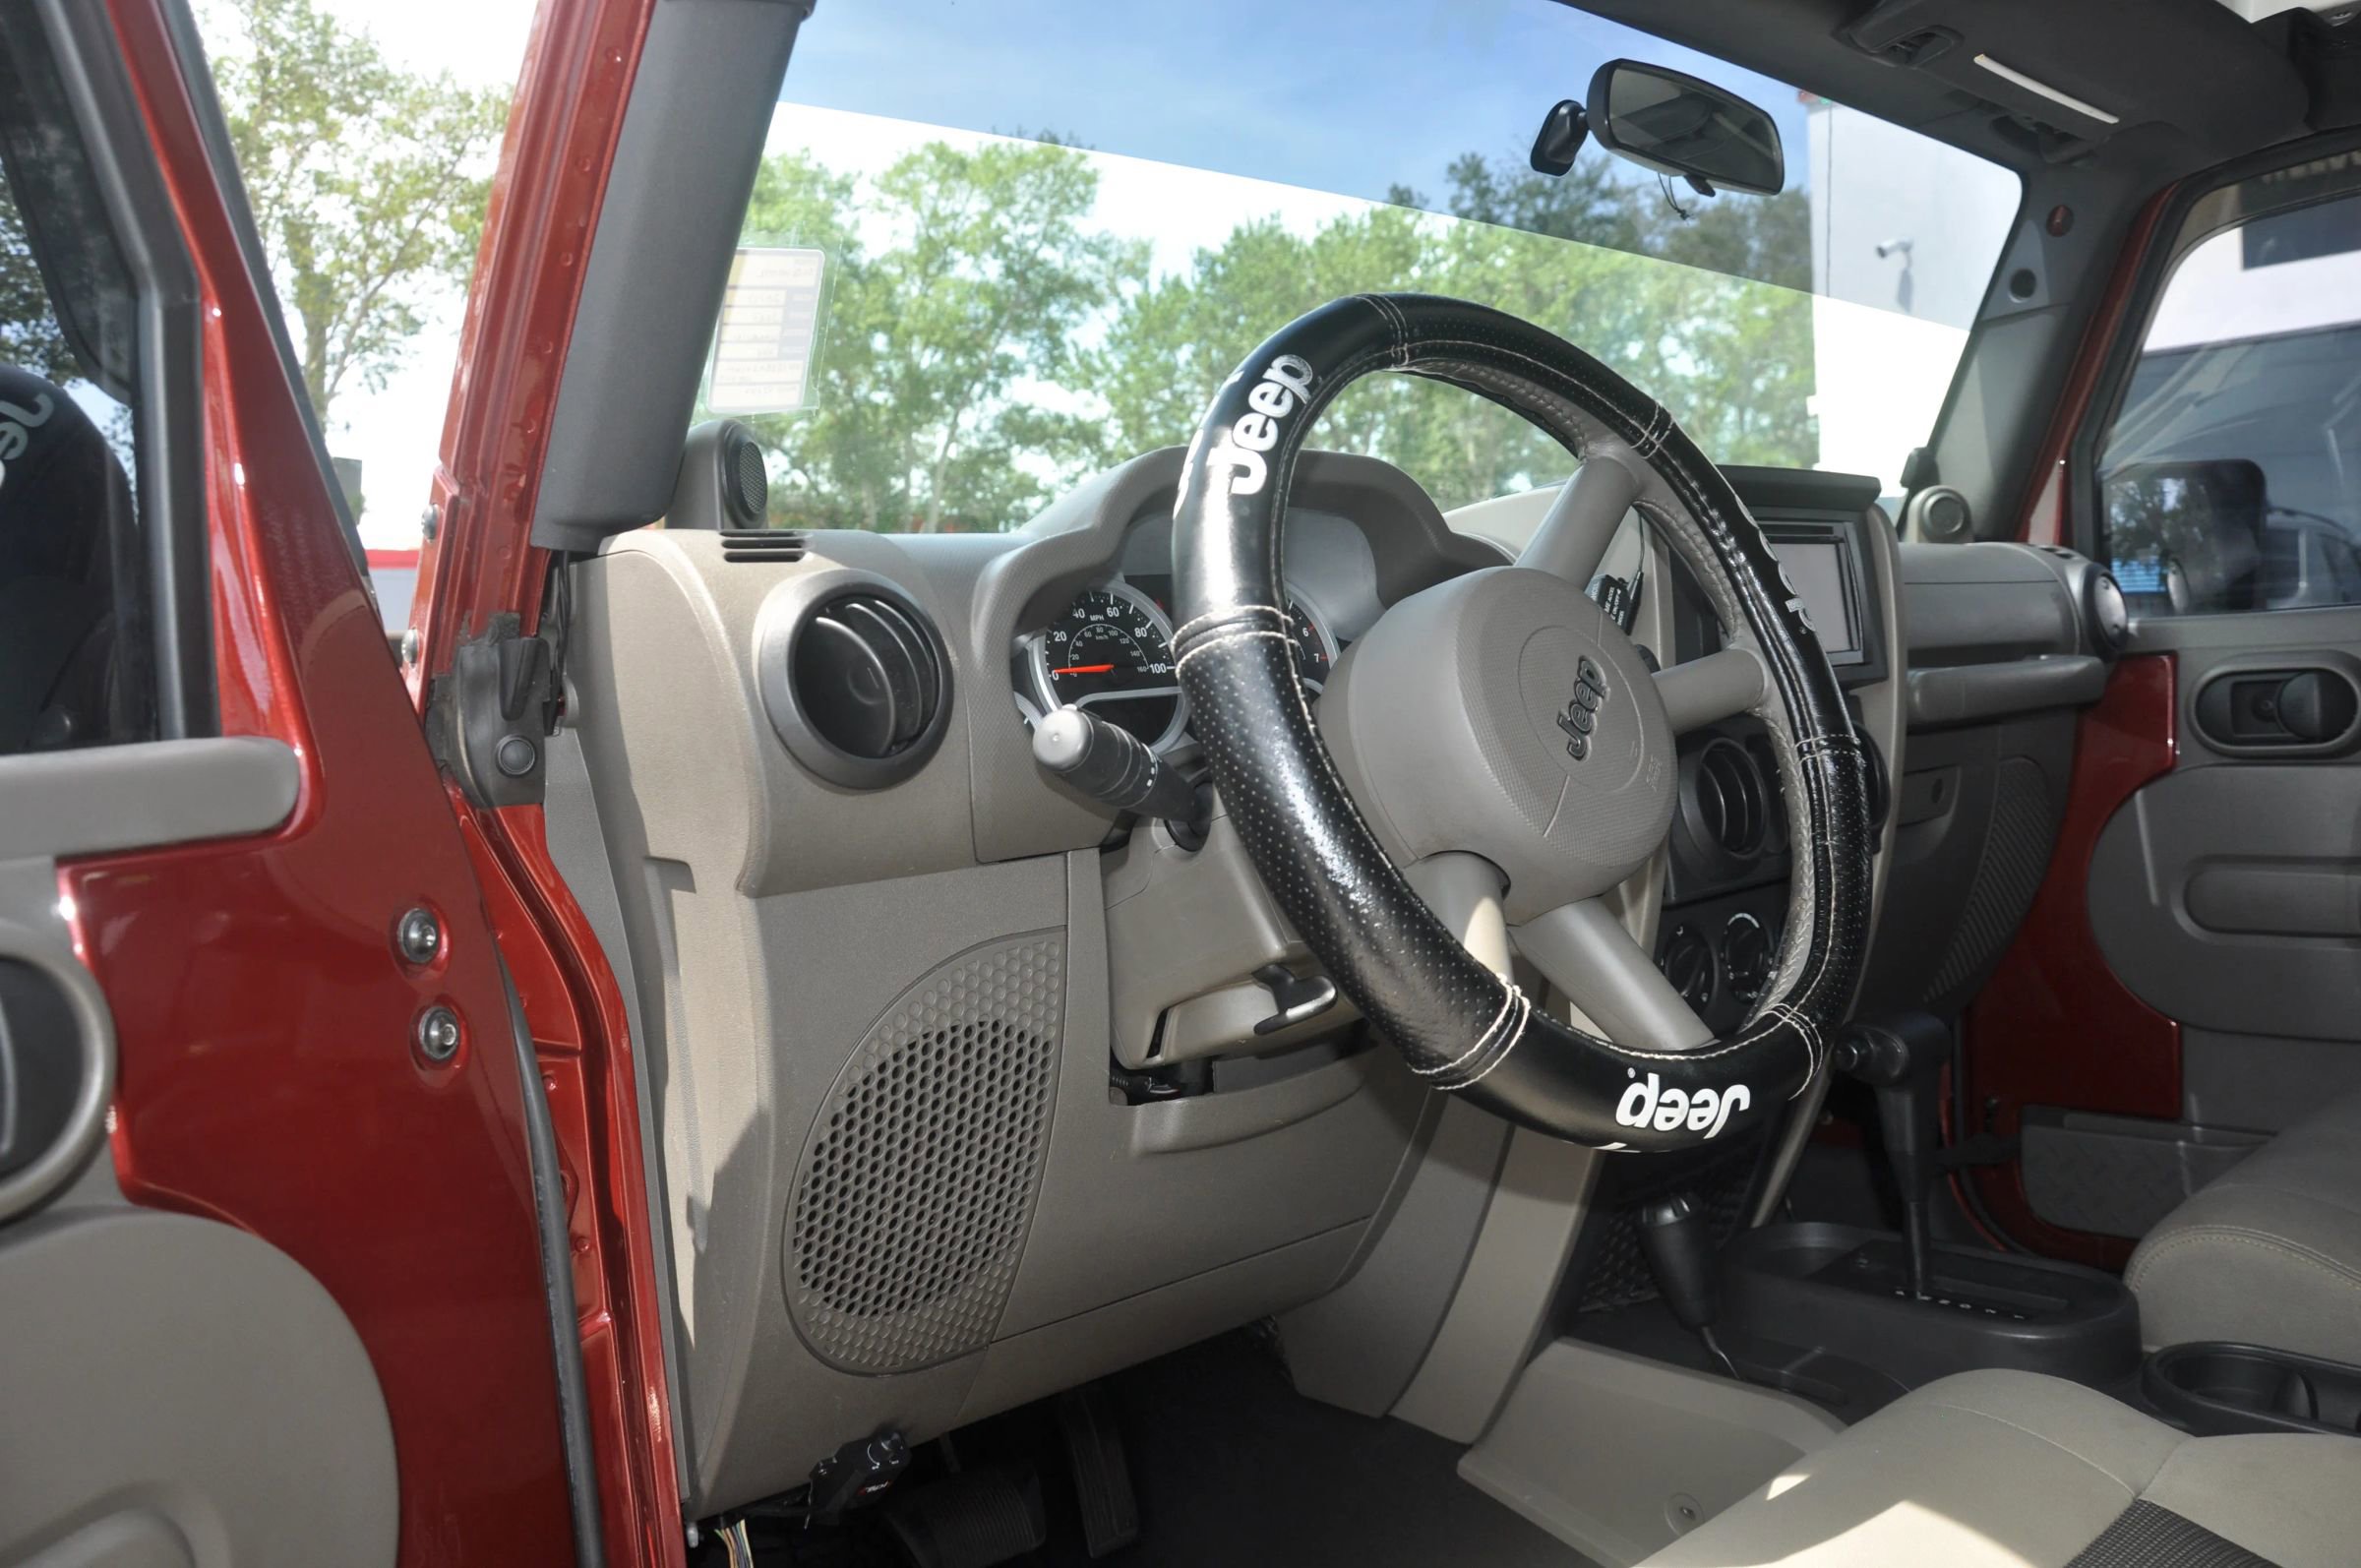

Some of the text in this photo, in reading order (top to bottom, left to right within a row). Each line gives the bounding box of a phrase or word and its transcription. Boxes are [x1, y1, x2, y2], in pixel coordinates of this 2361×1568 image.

[1206, 354, 1313, 495] Jeep
[1072, 608, 1086, 620] 40
[1106, 607, 1120, 618] 60
[1053, 631, 1067, 642] 20
[1134, 627, 1148, 638] 80
[1302, 627, 1309, 637] 6
[1313, 653, 1320, 664] 7
[1149, 663, 1167, 674] 100
[1052, 670, 1059, 681] 0
[1557, 657, 1608, 761] Jeep
[1615, 1071, 1751, 1140] Jeep
